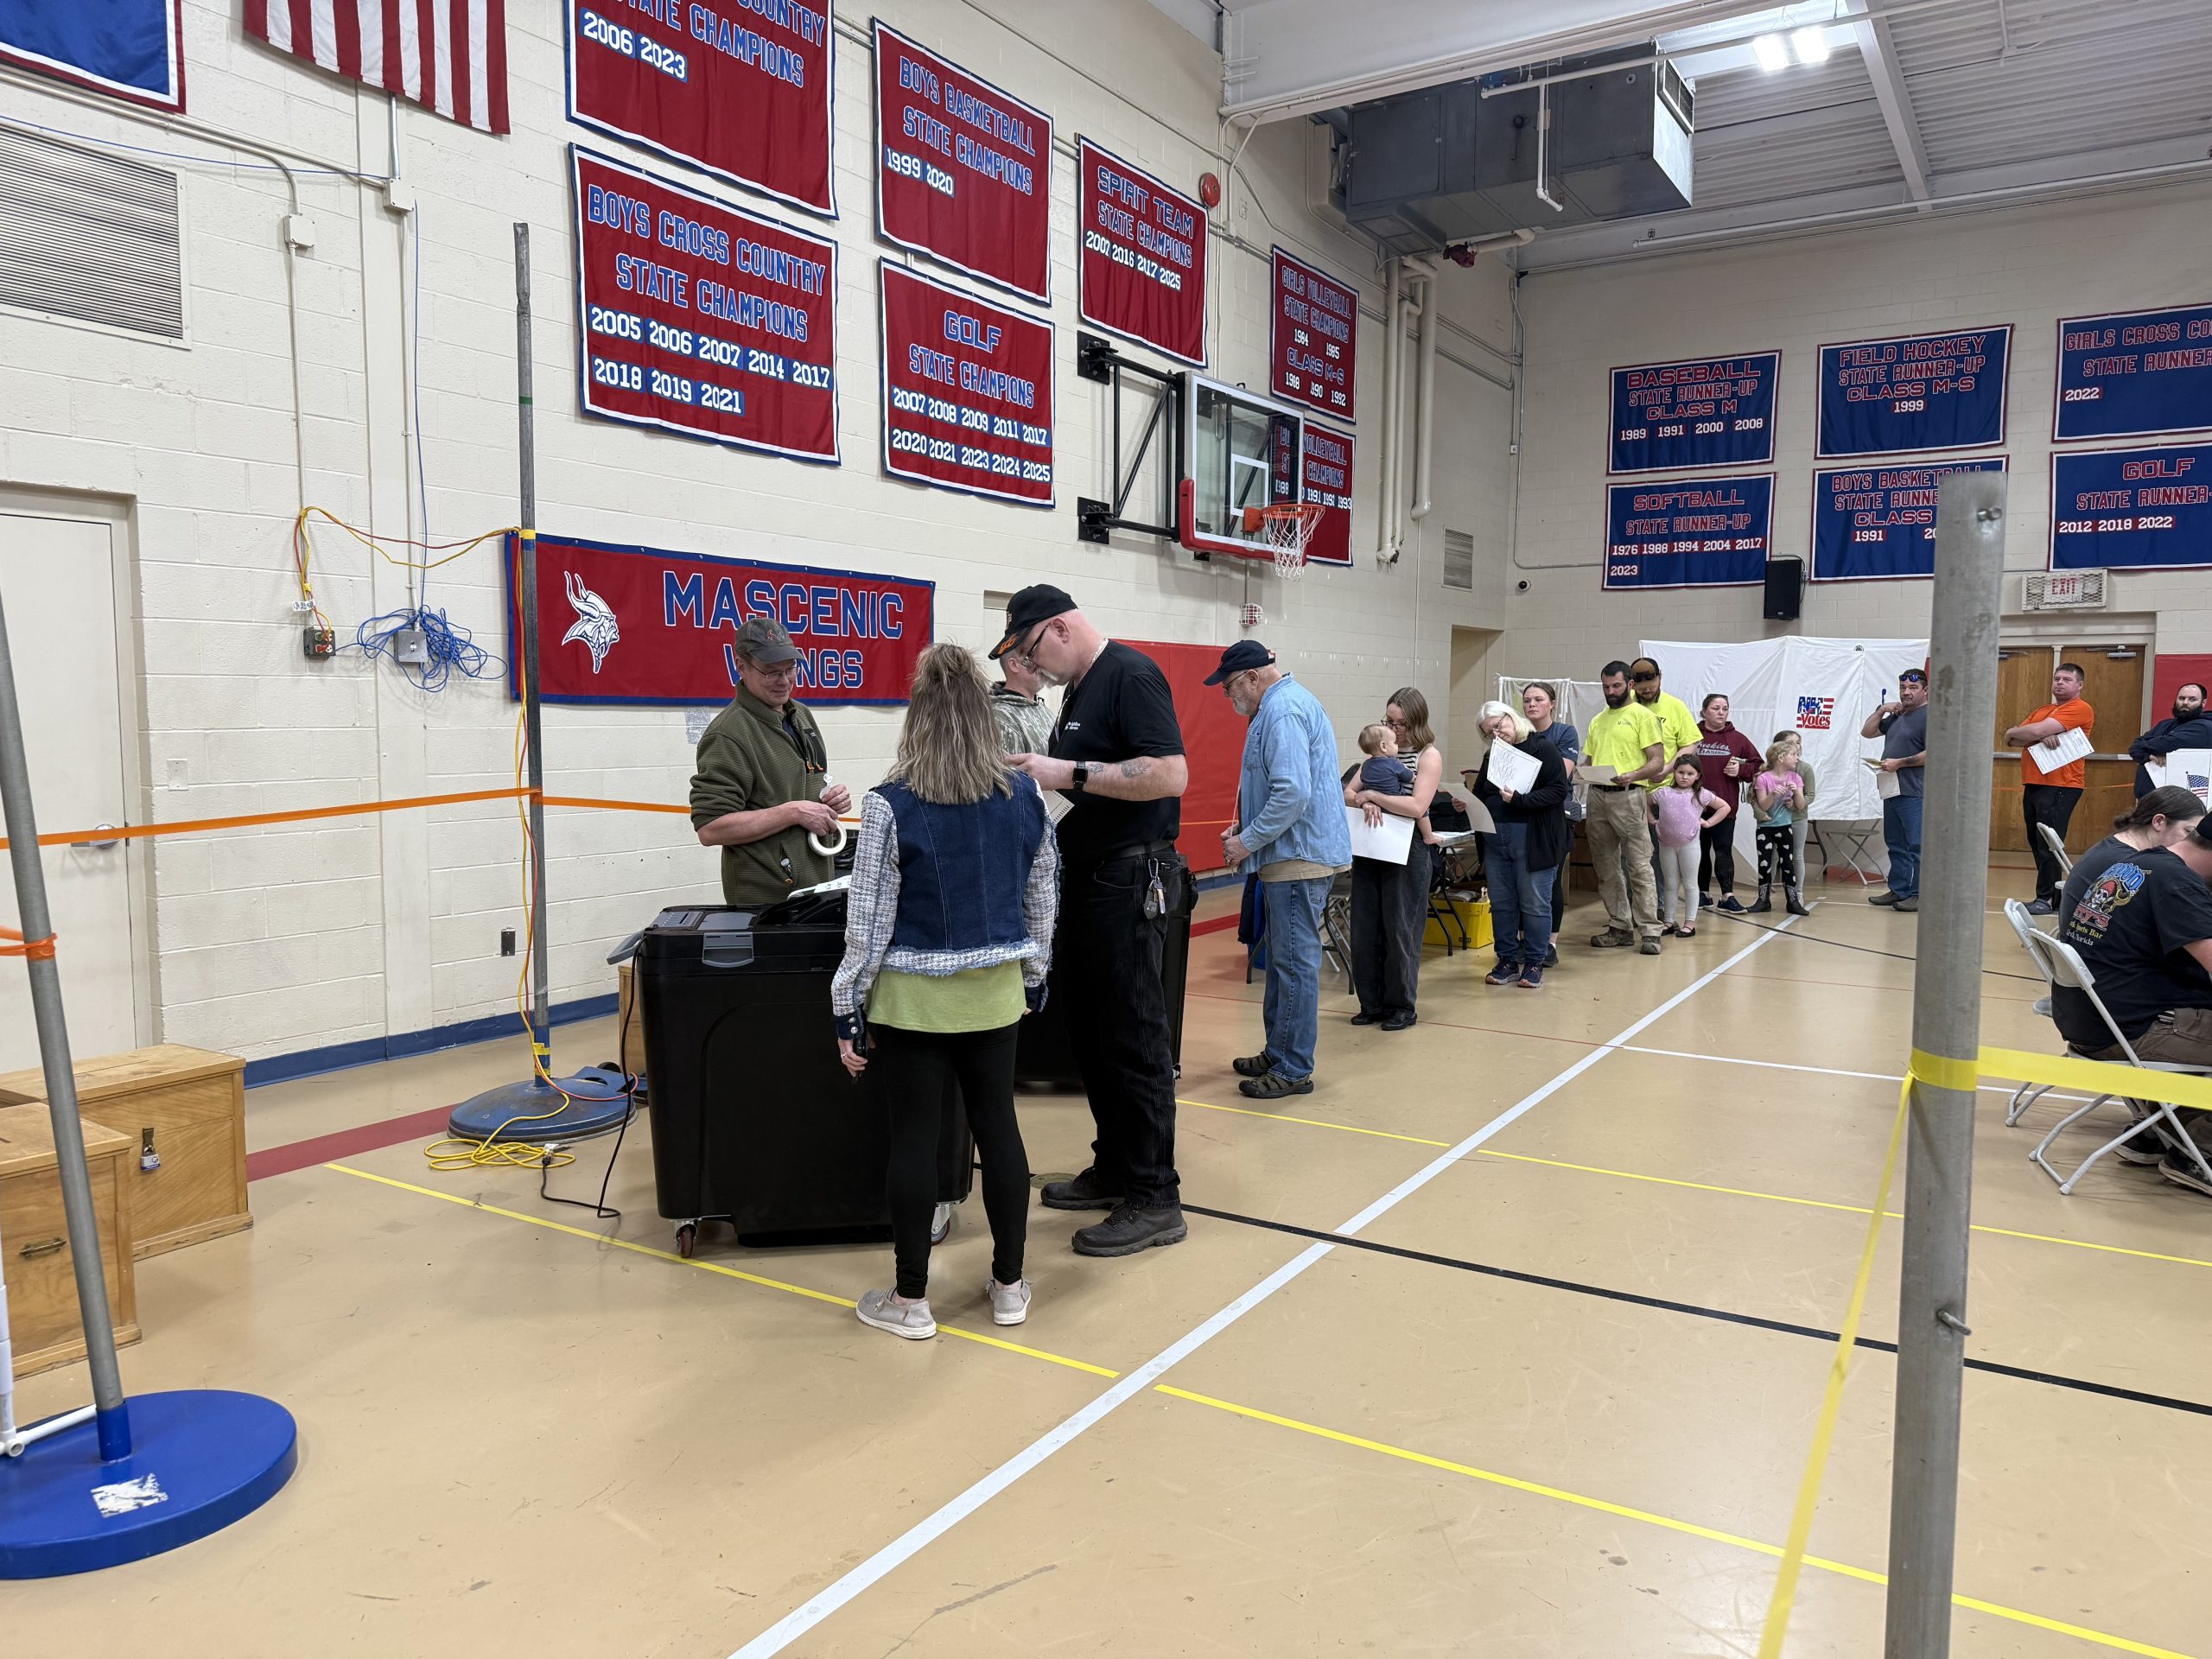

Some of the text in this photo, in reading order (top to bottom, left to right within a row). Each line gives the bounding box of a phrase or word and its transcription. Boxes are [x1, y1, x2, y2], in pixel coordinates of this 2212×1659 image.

[583, 11, 633, 55] 2006
[639, 36, 686, 80] 2023
[690, 3, 804, 88] CHAMPIONS
[899, 55, 1035, 156] BOYS BASKETBALL
[904, 105, 1033, 196] STATE CHAMPIONS
[887, 148, 953, 196] 1999 2020
[1098, 165, 1193, 238] SPIRIT TEAM
[588, 184, 825, 296] BOYS CROSS COUNTRY
[1098, 200, 1192, 268] STATE CHAMPIONS
[1086, 231, 1110, 257] 2007
[1112, 245, 1135, 267] 2016
[1160, 268, 1181, 290] 2025
[616, 253, 808, 342] STATE CHAMPIONS
[1282, 265, 1351, 319] GIRLS VOLLEYBALL
[944, 310, 1001, 353] GOLF
[1285, 295, 1349, 343] STATE CHAMPIONS
[591, 307, 830, 389] 2005 2006 2007 2014 2017
[1294, 328, 1339, 359] 1984 1985
[2065, 319, 2212, 351] GIRLS CROSS CO
[1840, 335, 1986, 366] FIELD HOCKEY
[910, 343, 1034, 409] STATE CHAMPIONS
[1287, 347, 1344, 385] CLASS M-S
[1627, 361, 1760, 389] BASEBALL
[1839, 356, 1985, 386] STATE RUNNER-UP
[2083, 355, 2138, 377] STATE
[595, 359, 741, 413] 2018 2019 2021
[1332, 390, 1346, 406] 1992
[1629, 379, 1758, 407] STATE RUNNER-UP
[1847, 377, 1975, 402] CLASS M-S
[2065, 387, 2100, 402] 2022
[893, 389, 1046, 445] 2007 2008 2009 2011 2017
[1647, 400, 1737, 420] CLASS M
[1894, 400, 1924, 413] 1999
[1621, 418, 1763, 441] 1989 1991 2000 2008
[893, 429, 1050, 481] 2020 2021 2023 2024 2025
[2123, 458, 2196, 480] GOLF
[1307, 461, 1344, 489] CHAMPIONS
[1833, 465, 1981, 492] BOYS BASKET
[1634, 489, 1745, 511] SOFTBALL
[1835, 493, 1884, 511] STATE
[2076, 490, 2132, 511] STATE
[1626, 513, 1751, 536] STATE RUNNER-UP
[1854, 510, 1933, 527] CLASS
[2059, 516, 2172, 533] 2012 2018 2022
[1612, 537, 1763, 556] 1976 1988 1994 2004 2017
[1855, 530, 1884, 542] 1991
[1611, 565, 1638, 576] 2023
[2051, 577, 2076, 594] EXIT
[663, 570, 904, 640] MASCENIC
[1801, 709, 1831, 727] Votes
